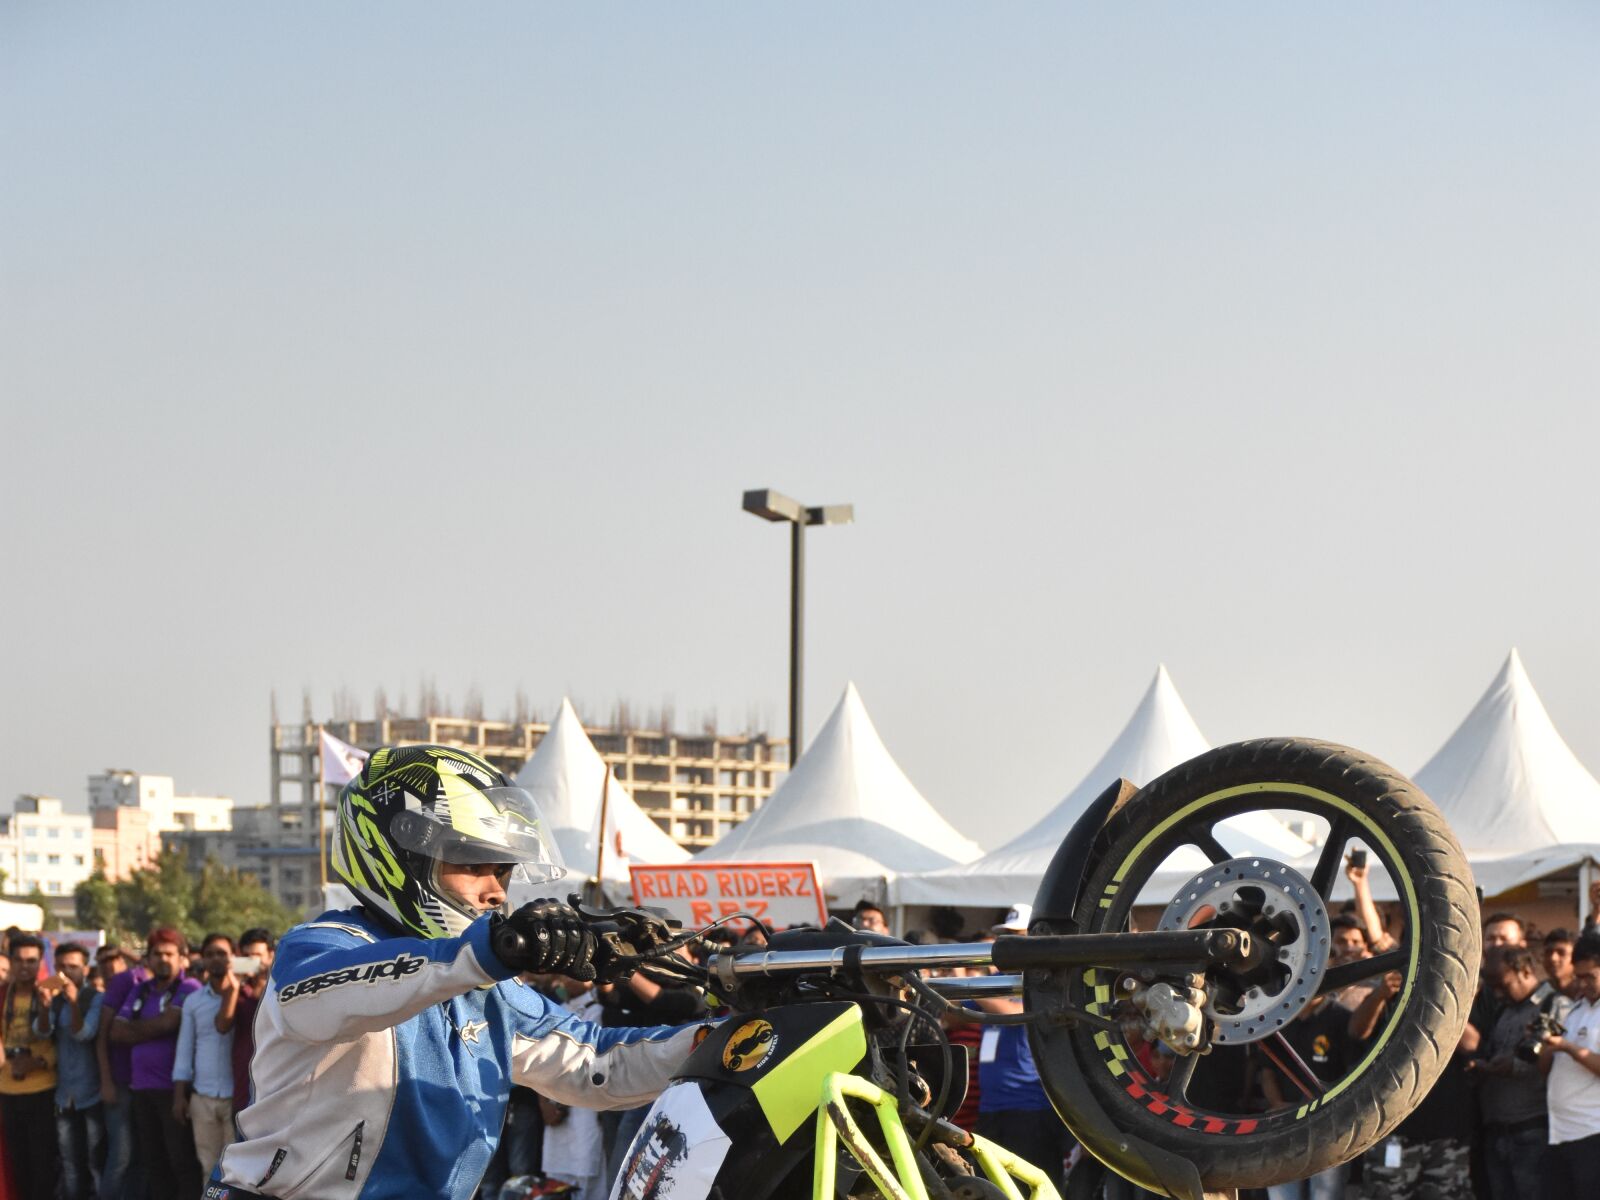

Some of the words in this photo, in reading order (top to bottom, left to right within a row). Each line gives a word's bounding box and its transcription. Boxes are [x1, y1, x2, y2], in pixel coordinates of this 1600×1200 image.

[639, 871, 708, 898] ROAD
[716, 870, 812, 897] RIDERZ
[280, 956, 425, 1003] alpinestars
[756, 1056, 770, 1069] RIDE
